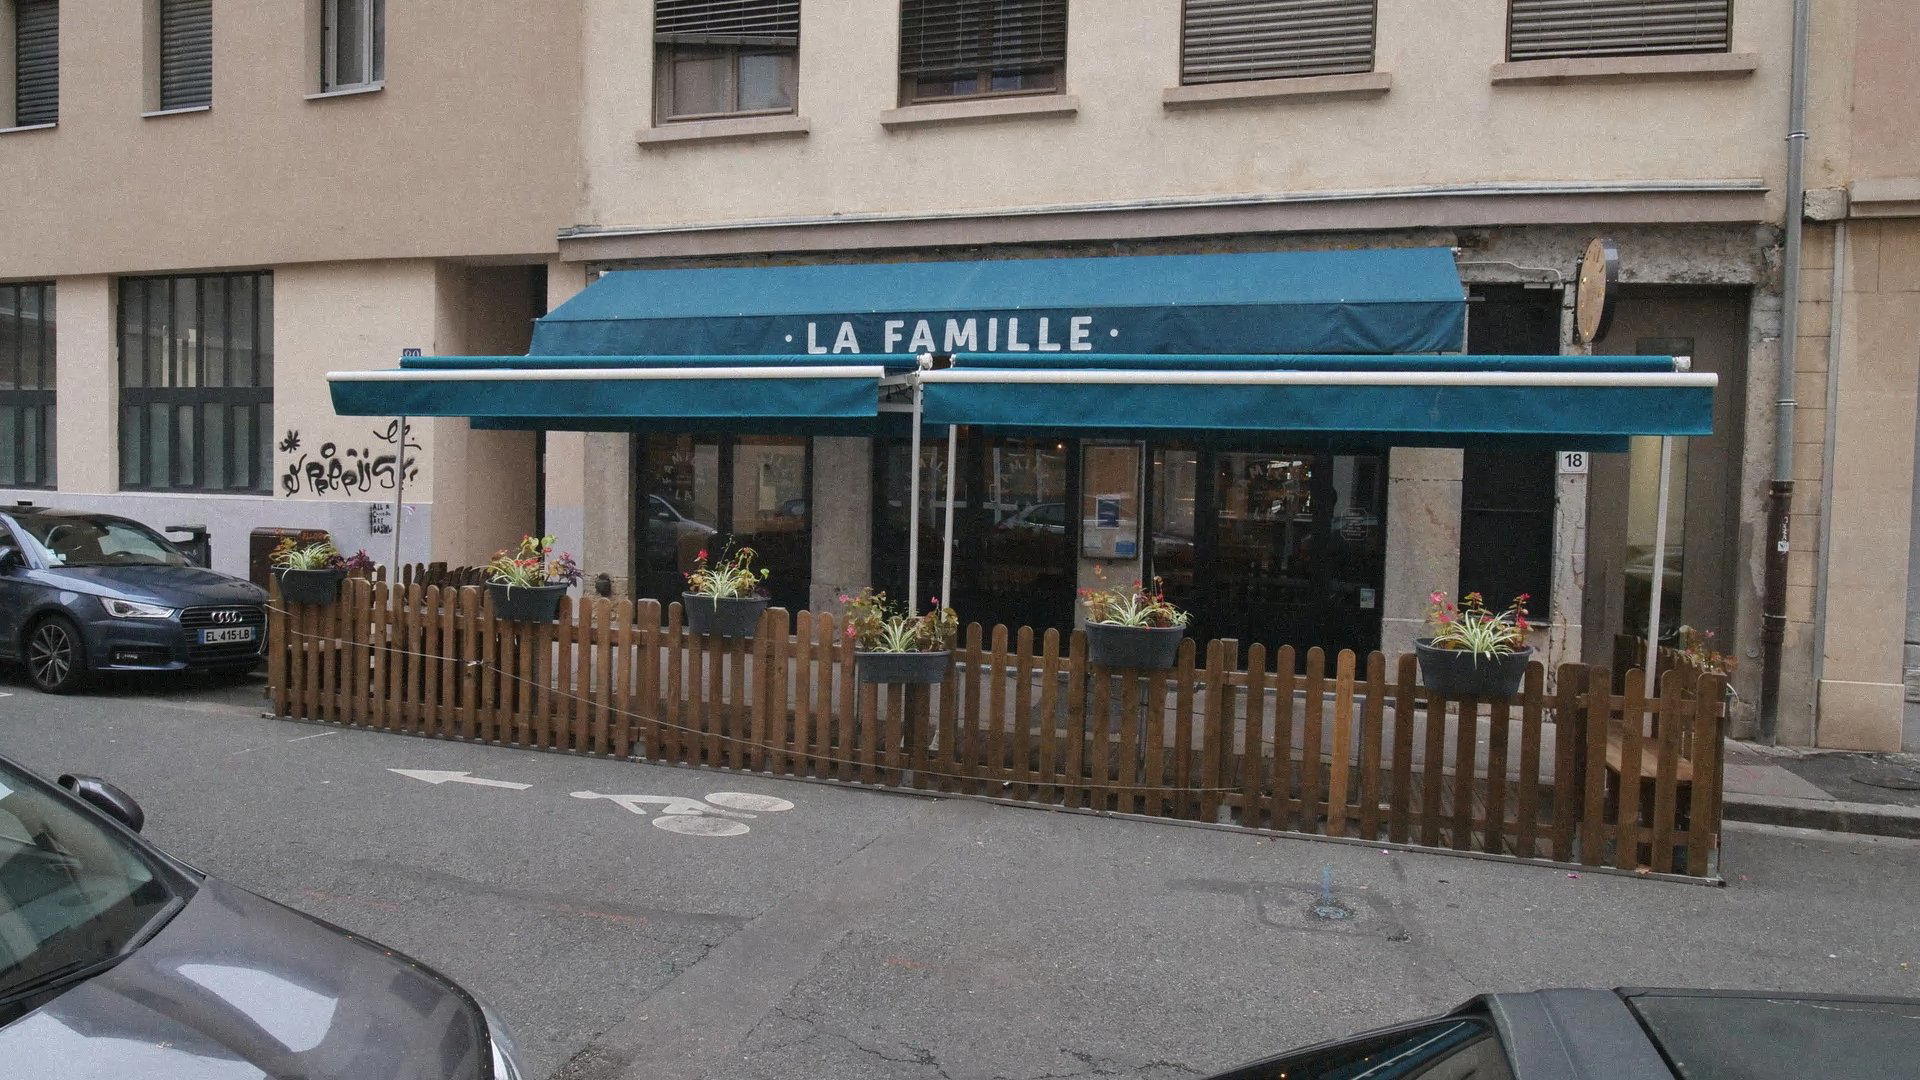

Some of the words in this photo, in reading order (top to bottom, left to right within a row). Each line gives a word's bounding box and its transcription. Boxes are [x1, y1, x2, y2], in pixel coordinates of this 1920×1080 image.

[807, 321, 860, 355] LA
[884, 315, 1093, 354] FAMILLE
[1564, 453, 1583, 468] 18
